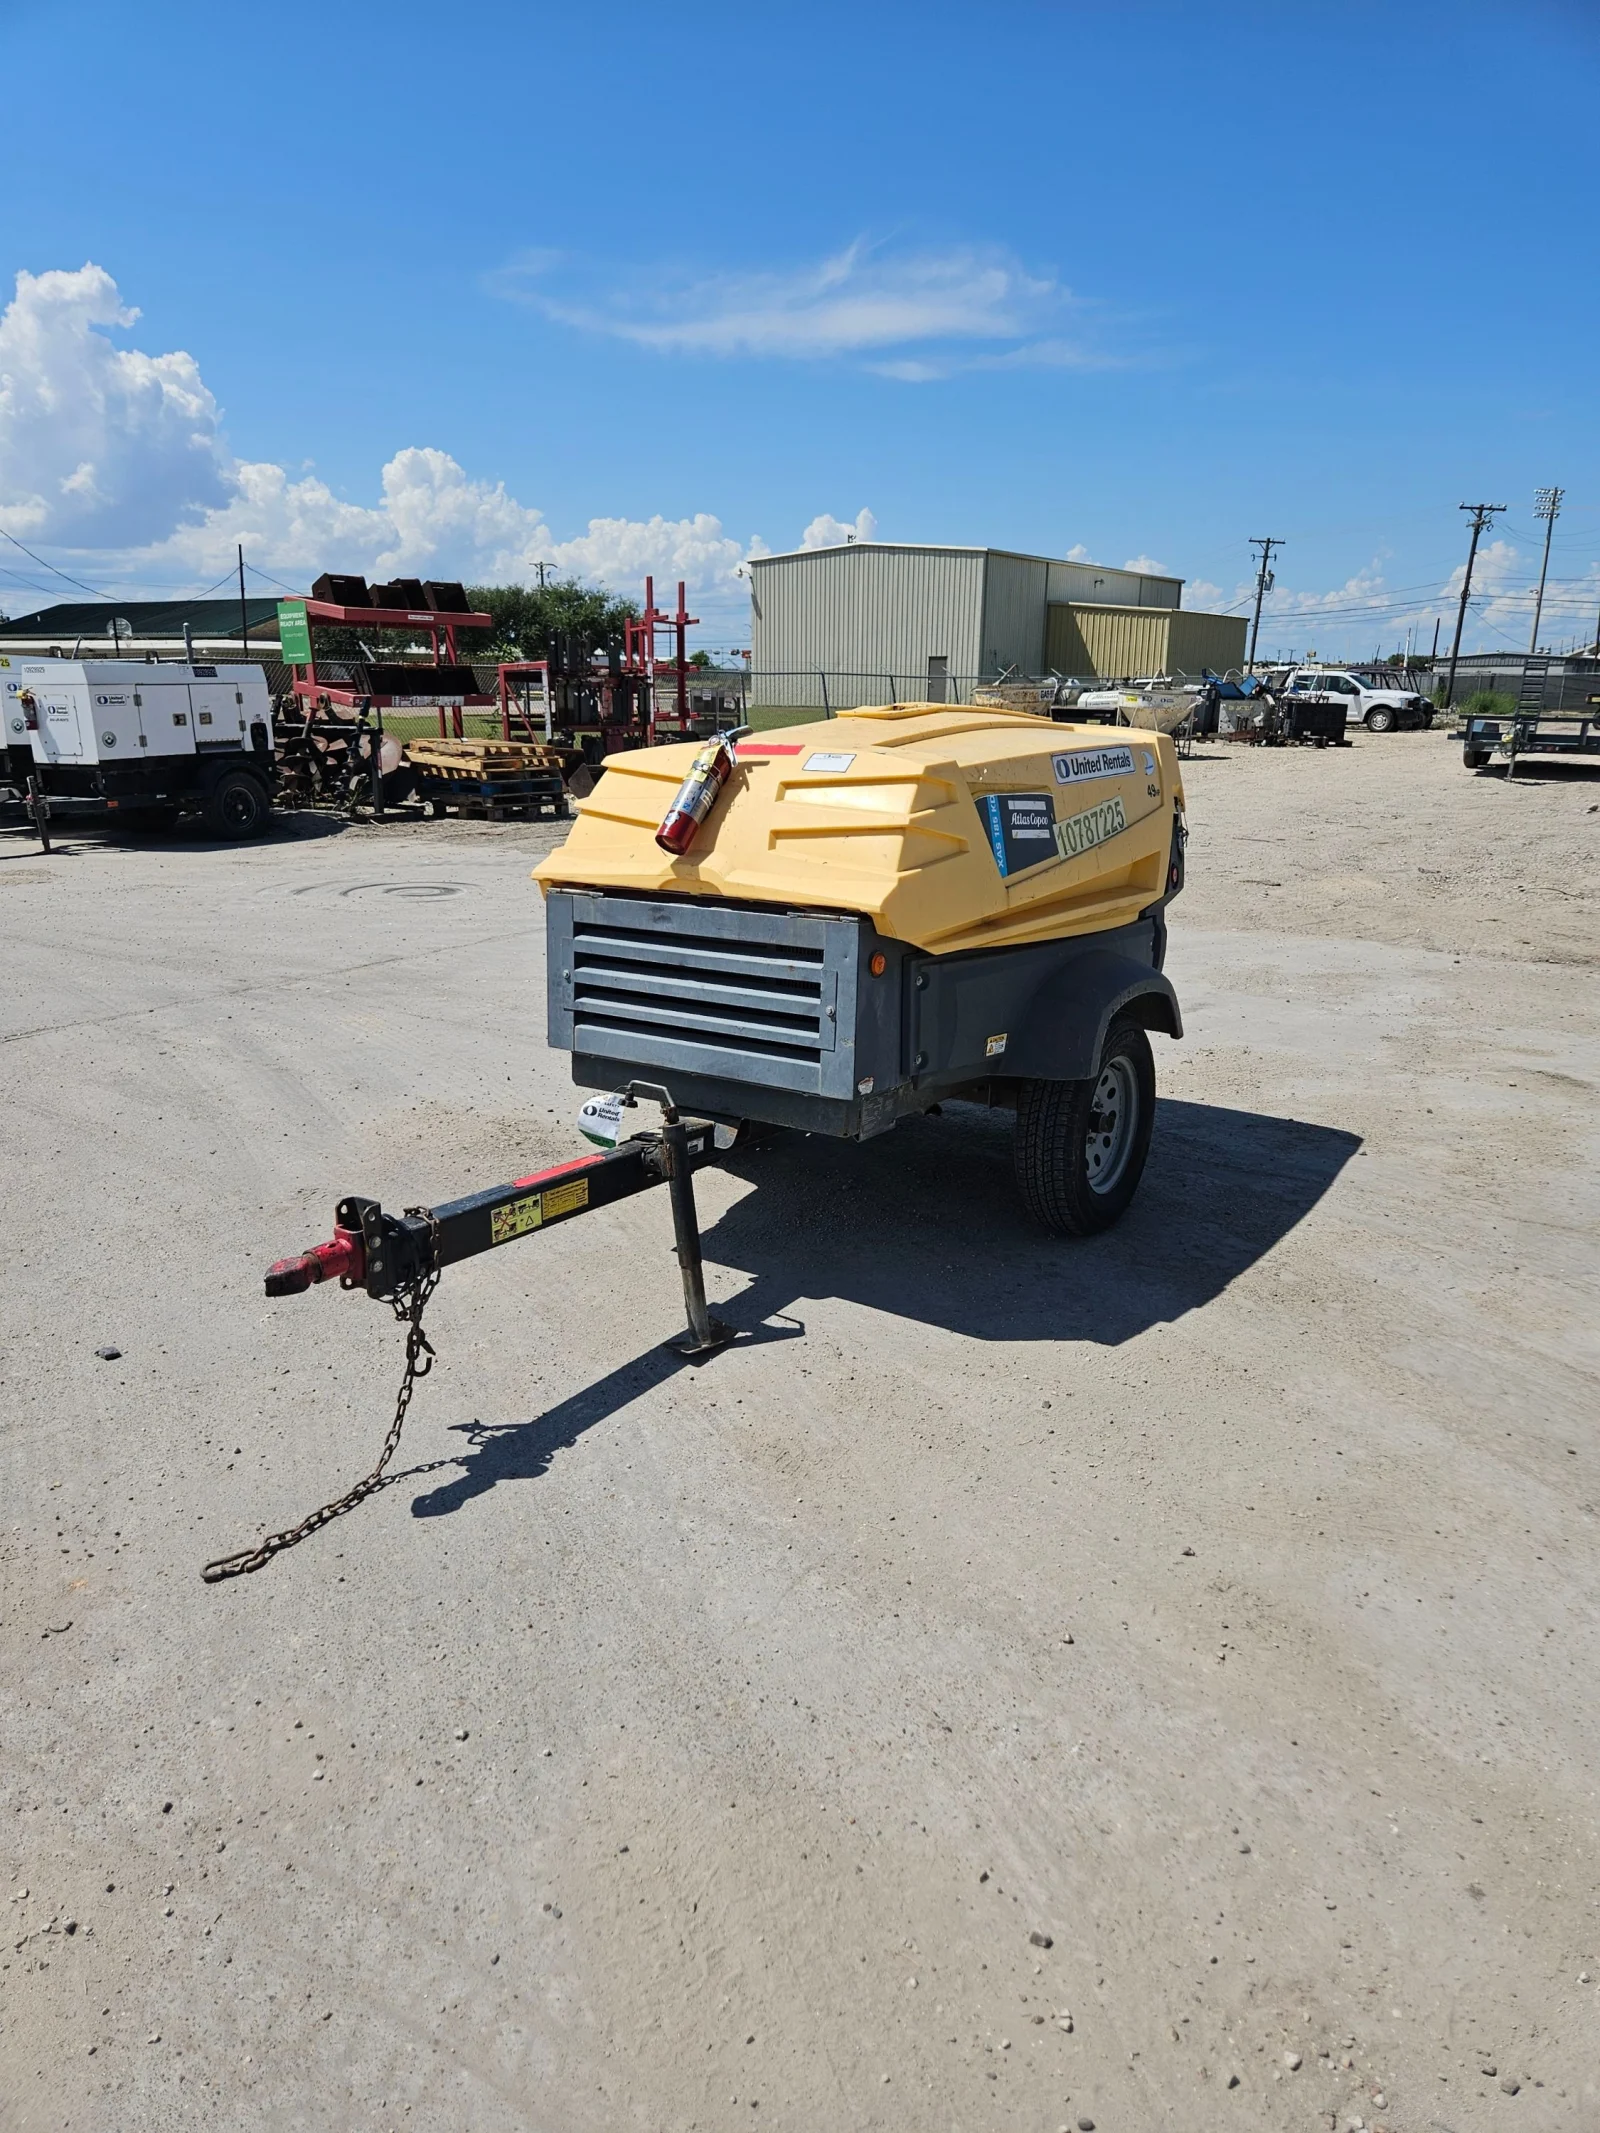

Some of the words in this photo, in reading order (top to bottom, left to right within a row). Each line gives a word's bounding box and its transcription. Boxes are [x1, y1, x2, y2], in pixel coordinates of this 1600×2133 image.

[1071, 755, 1101, 775] United
[1102, 752, 1131, 770] Rentals
[1011, 812, 1030, 825] Atlas
[1030, 812, 1048, 827] Copco
[1057, 801, 1125, 856] 10787225
[996, 842, 1004, 868] XAS
[597, 1112, 620, 1121] Rentals
[599, 1107, 620, 1117] United
